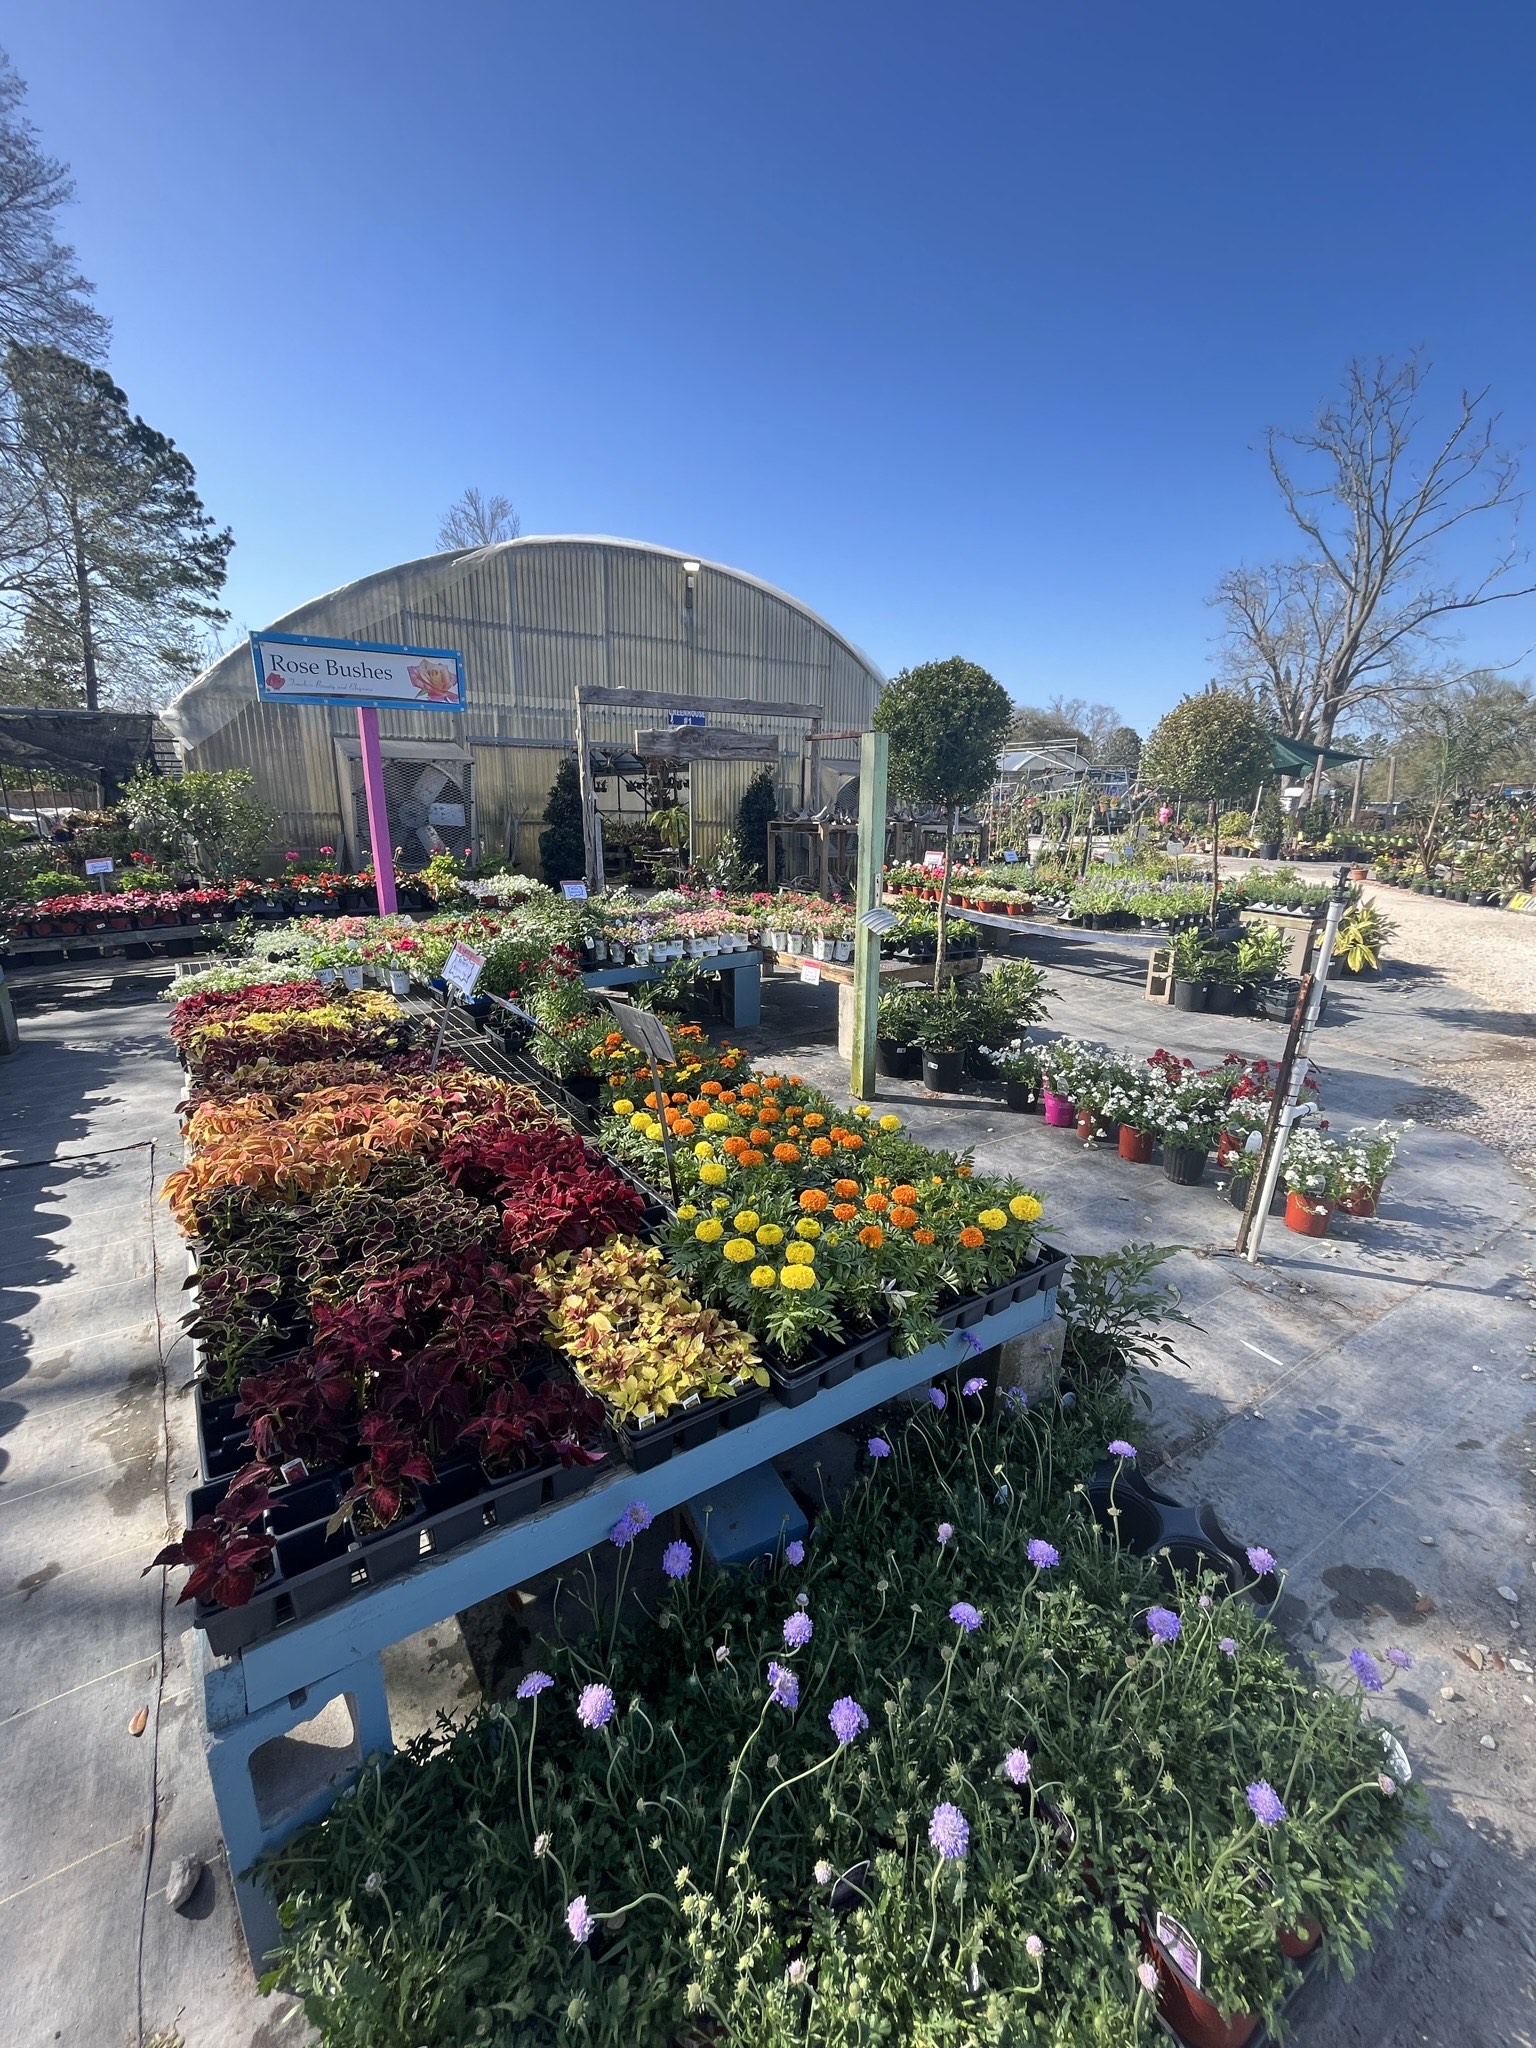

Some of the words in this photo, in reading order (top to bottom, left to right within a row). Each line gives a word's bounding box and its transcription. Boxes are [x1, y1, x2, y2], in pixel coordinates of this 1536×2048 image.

[269, 653, 320, 675] Rose
[325, 658, 393, 681] Bushes
[316, 680, 336, 690] Beauty
[349, 682, 374, 692] Elegance
